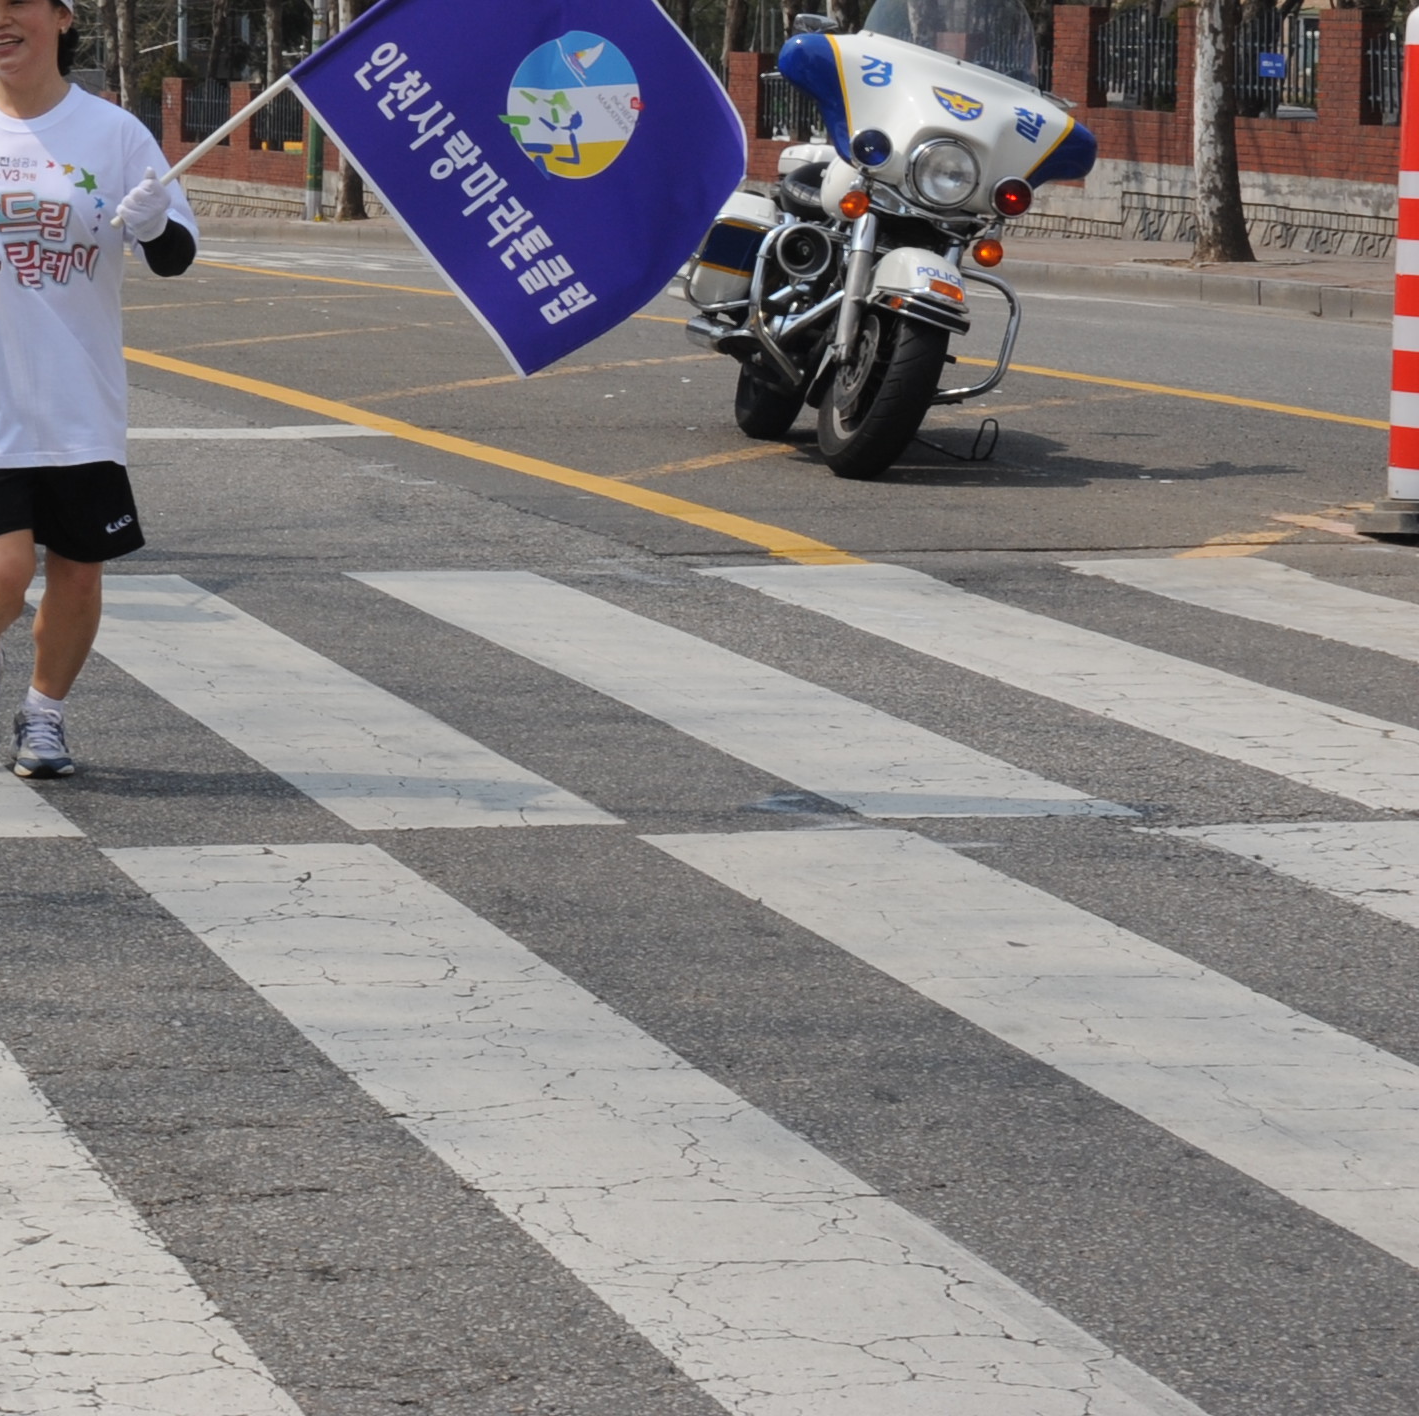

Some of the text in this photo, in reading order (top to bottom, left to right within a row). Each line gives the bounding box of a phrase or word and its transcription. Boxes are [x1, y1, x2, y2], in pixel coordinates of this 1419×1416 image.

[860, 54, 893, 88] 경
[597, 94, 630, 135] MARATHON
[1013, 106, 1047, 144] 찰
[2, 169, 21, 182] V3
[11, 158, 39, 169] 성공과
[353, 41, 598, 326] 인천사랑마라톤클럽
[4, 240, 100, 290] 릴레이
[916, 266, 964, 288] POLICE
